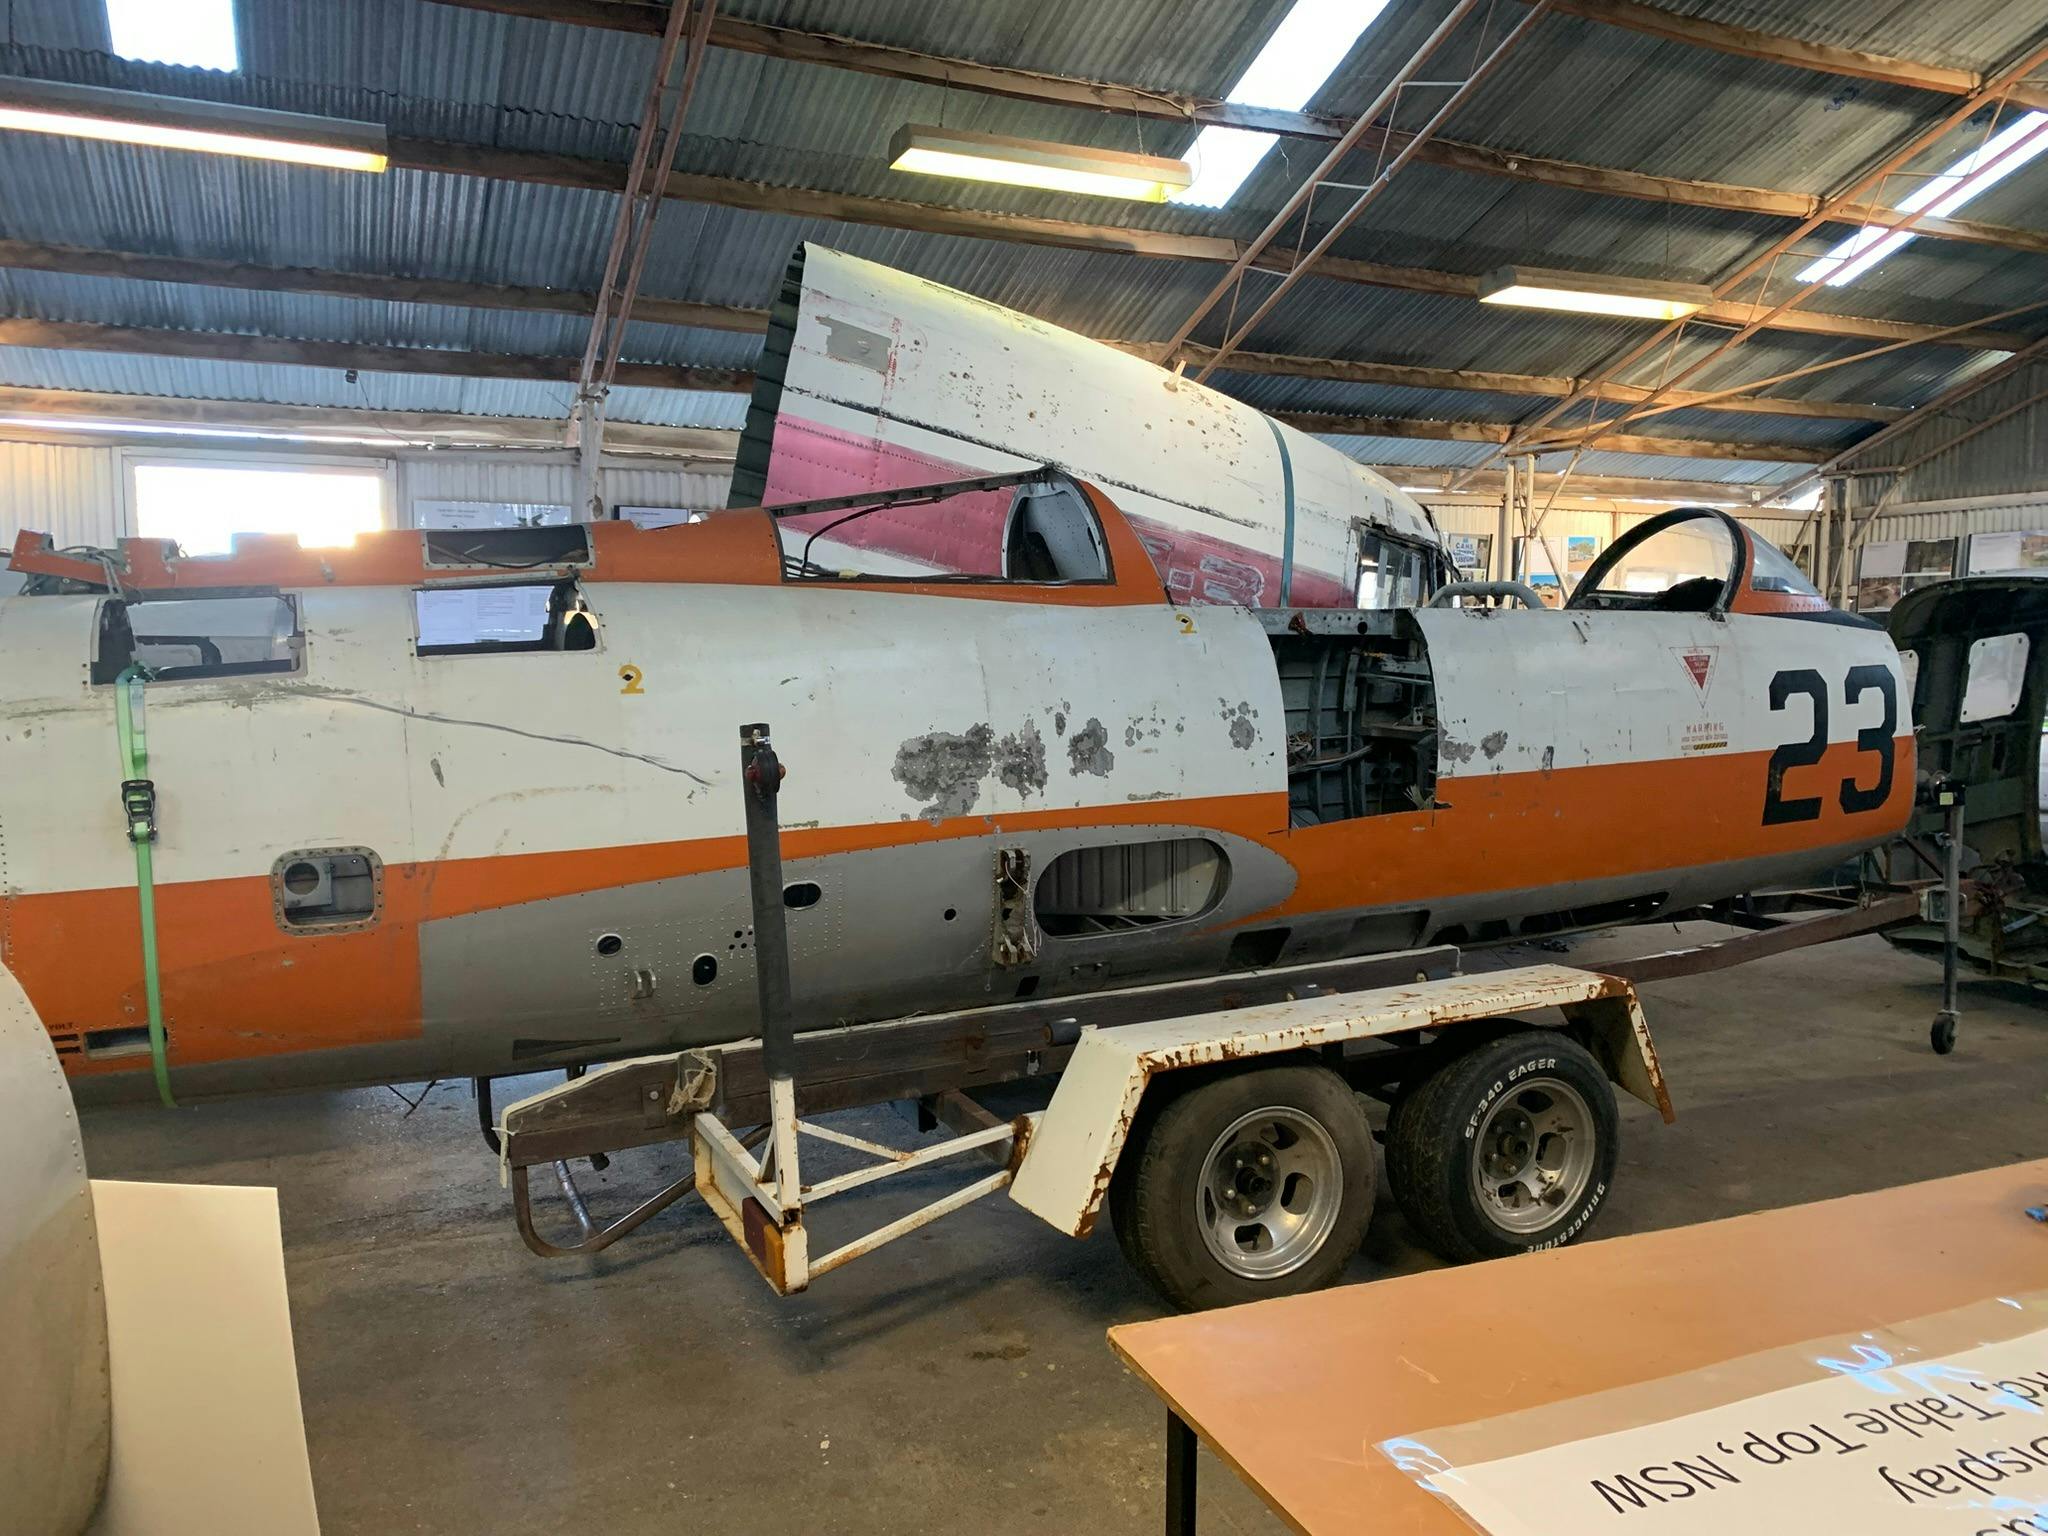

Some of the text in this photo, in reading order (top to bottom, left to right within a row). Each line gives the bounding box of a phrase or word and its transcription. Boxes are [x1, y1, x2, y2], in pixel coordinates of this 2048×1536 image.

[1176, 613, 1198, 634] 2
[618, 664, 645, 695] 2
[1686, 721, 1725, 735] WARNING
[1762, 664, 1897, 826] 23
[1465, 1058, 1556, 1140] SF-340 EAGER
[1843, 1393, 2007, 1439] Table
[1717, 1423, 1868, 1465] Top,
[1590, 1455, 1742, 1514] NSW
